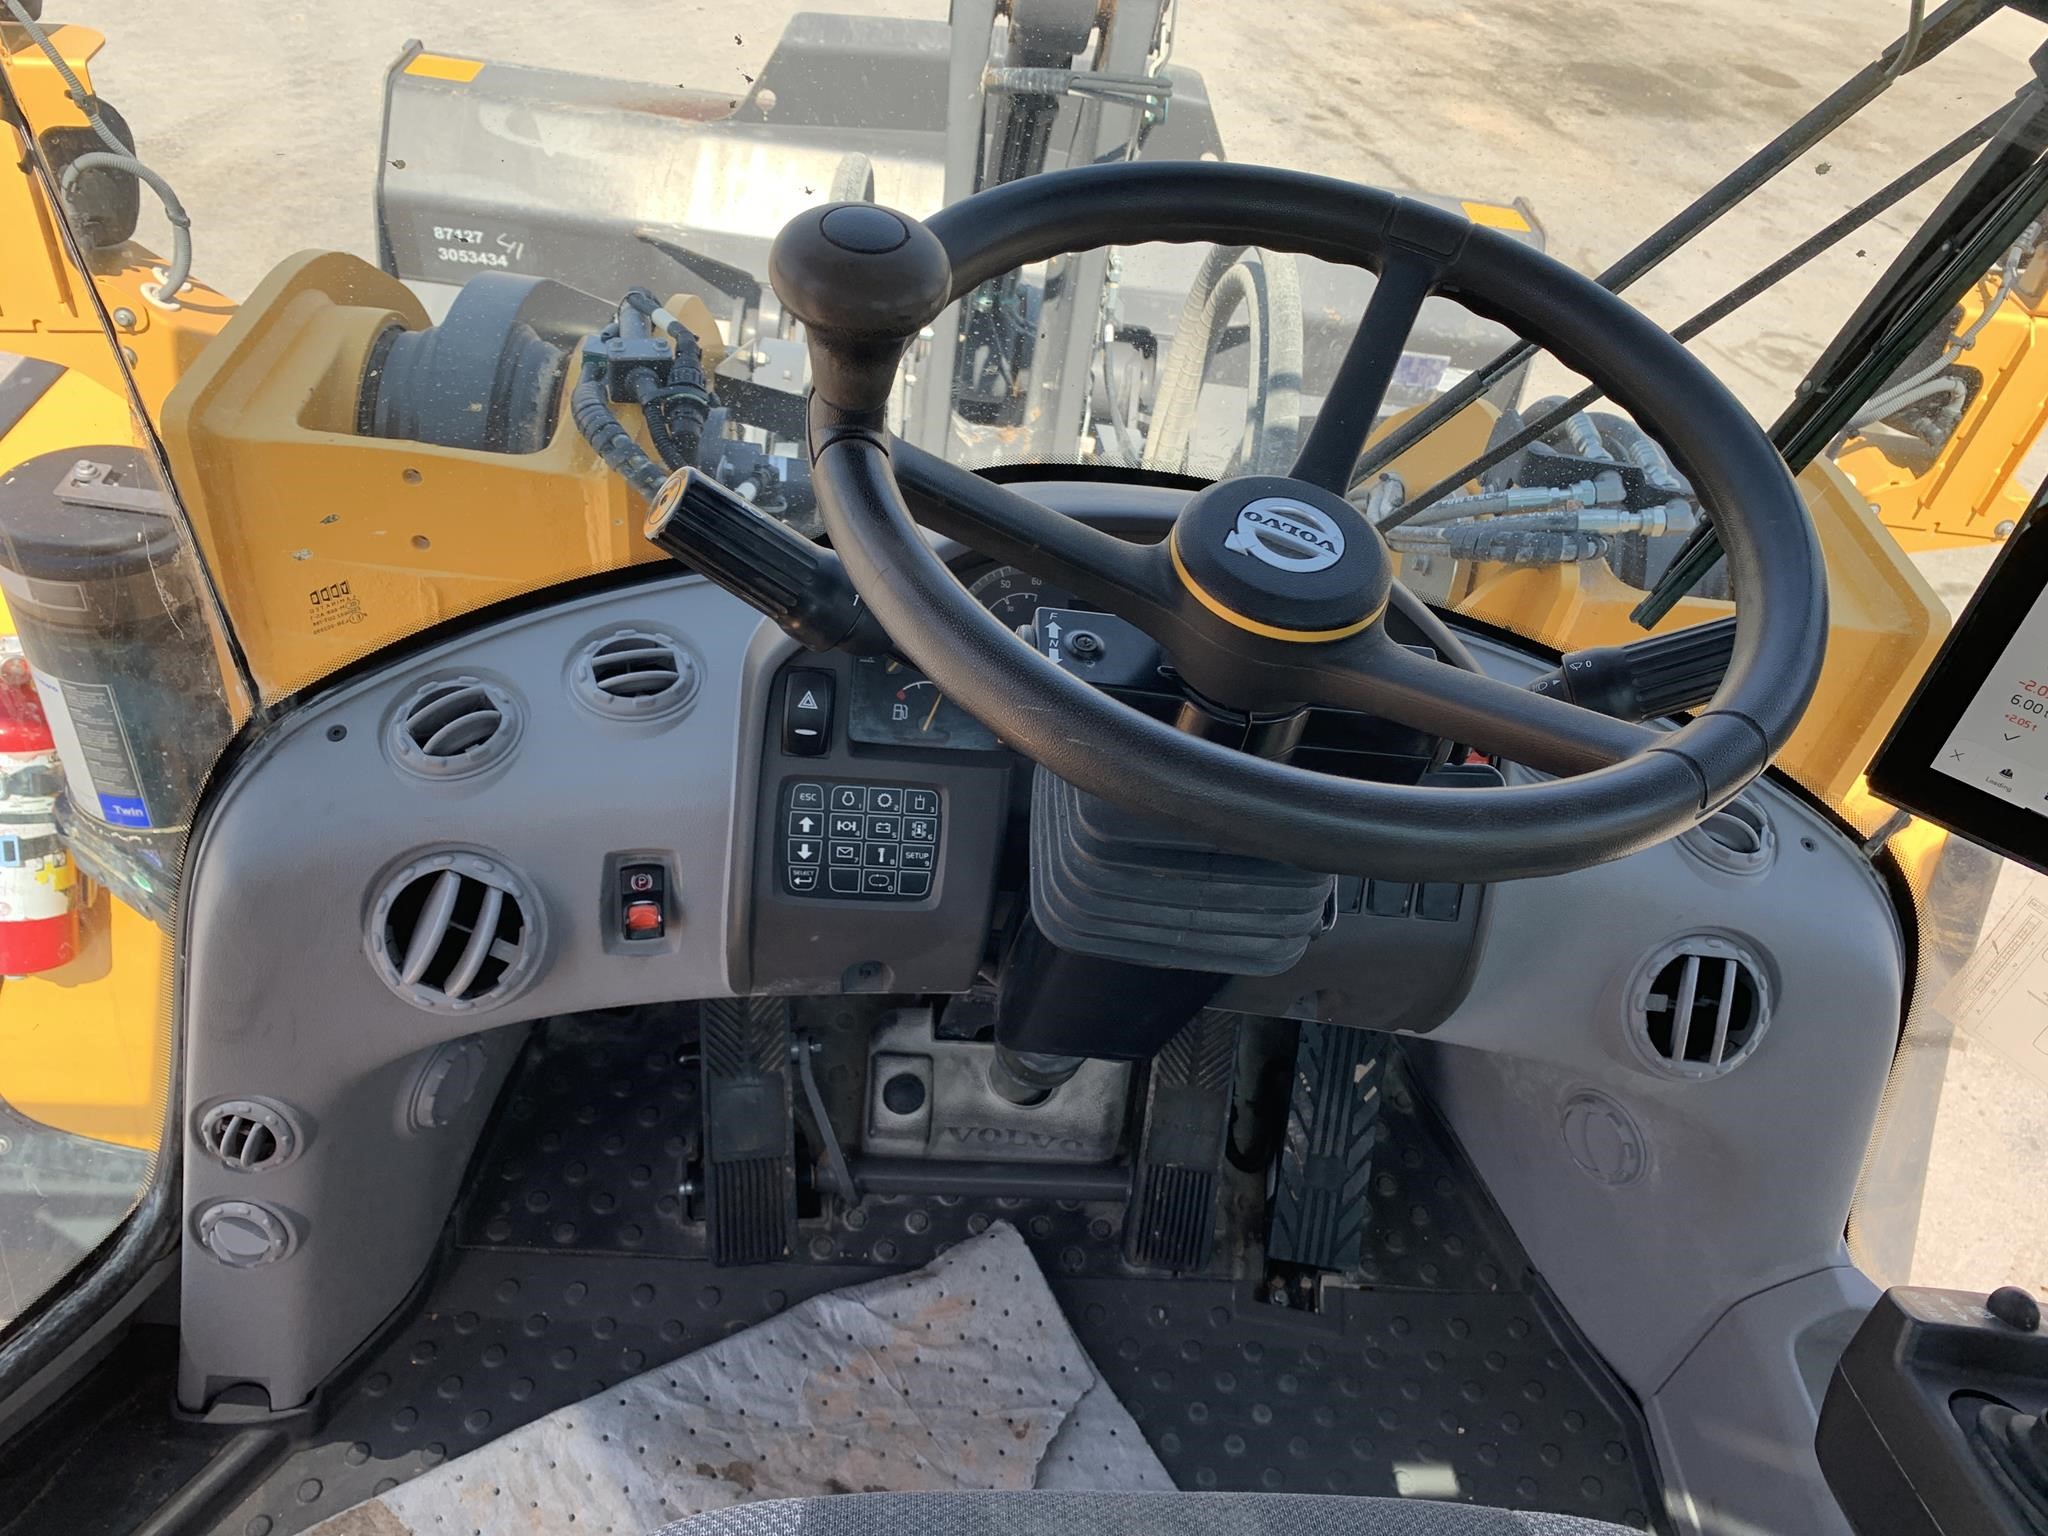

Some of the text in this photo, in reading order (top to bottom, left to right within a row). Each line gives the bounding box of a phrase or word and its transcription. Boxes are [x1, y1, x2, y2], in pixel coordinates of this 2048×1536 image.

[438, 247, 508, 267] 3053434
[1244, 511, 1338, 555] VOLVO
[1000, 580, 1011, 588] 50
[1049, 612, 1058, 620] F
[1049, 639, 1059, 648] N
[2019, 680, 2048, 699] -2.0
[2010, 694, 2044, 714] 6.00
[800, 792, 817, 801] ESC
[112, 805, 145, 817] Twin
[905, 851, 930, 860] SETUP
[944, 1126, 1084, 1152] VOLVO
